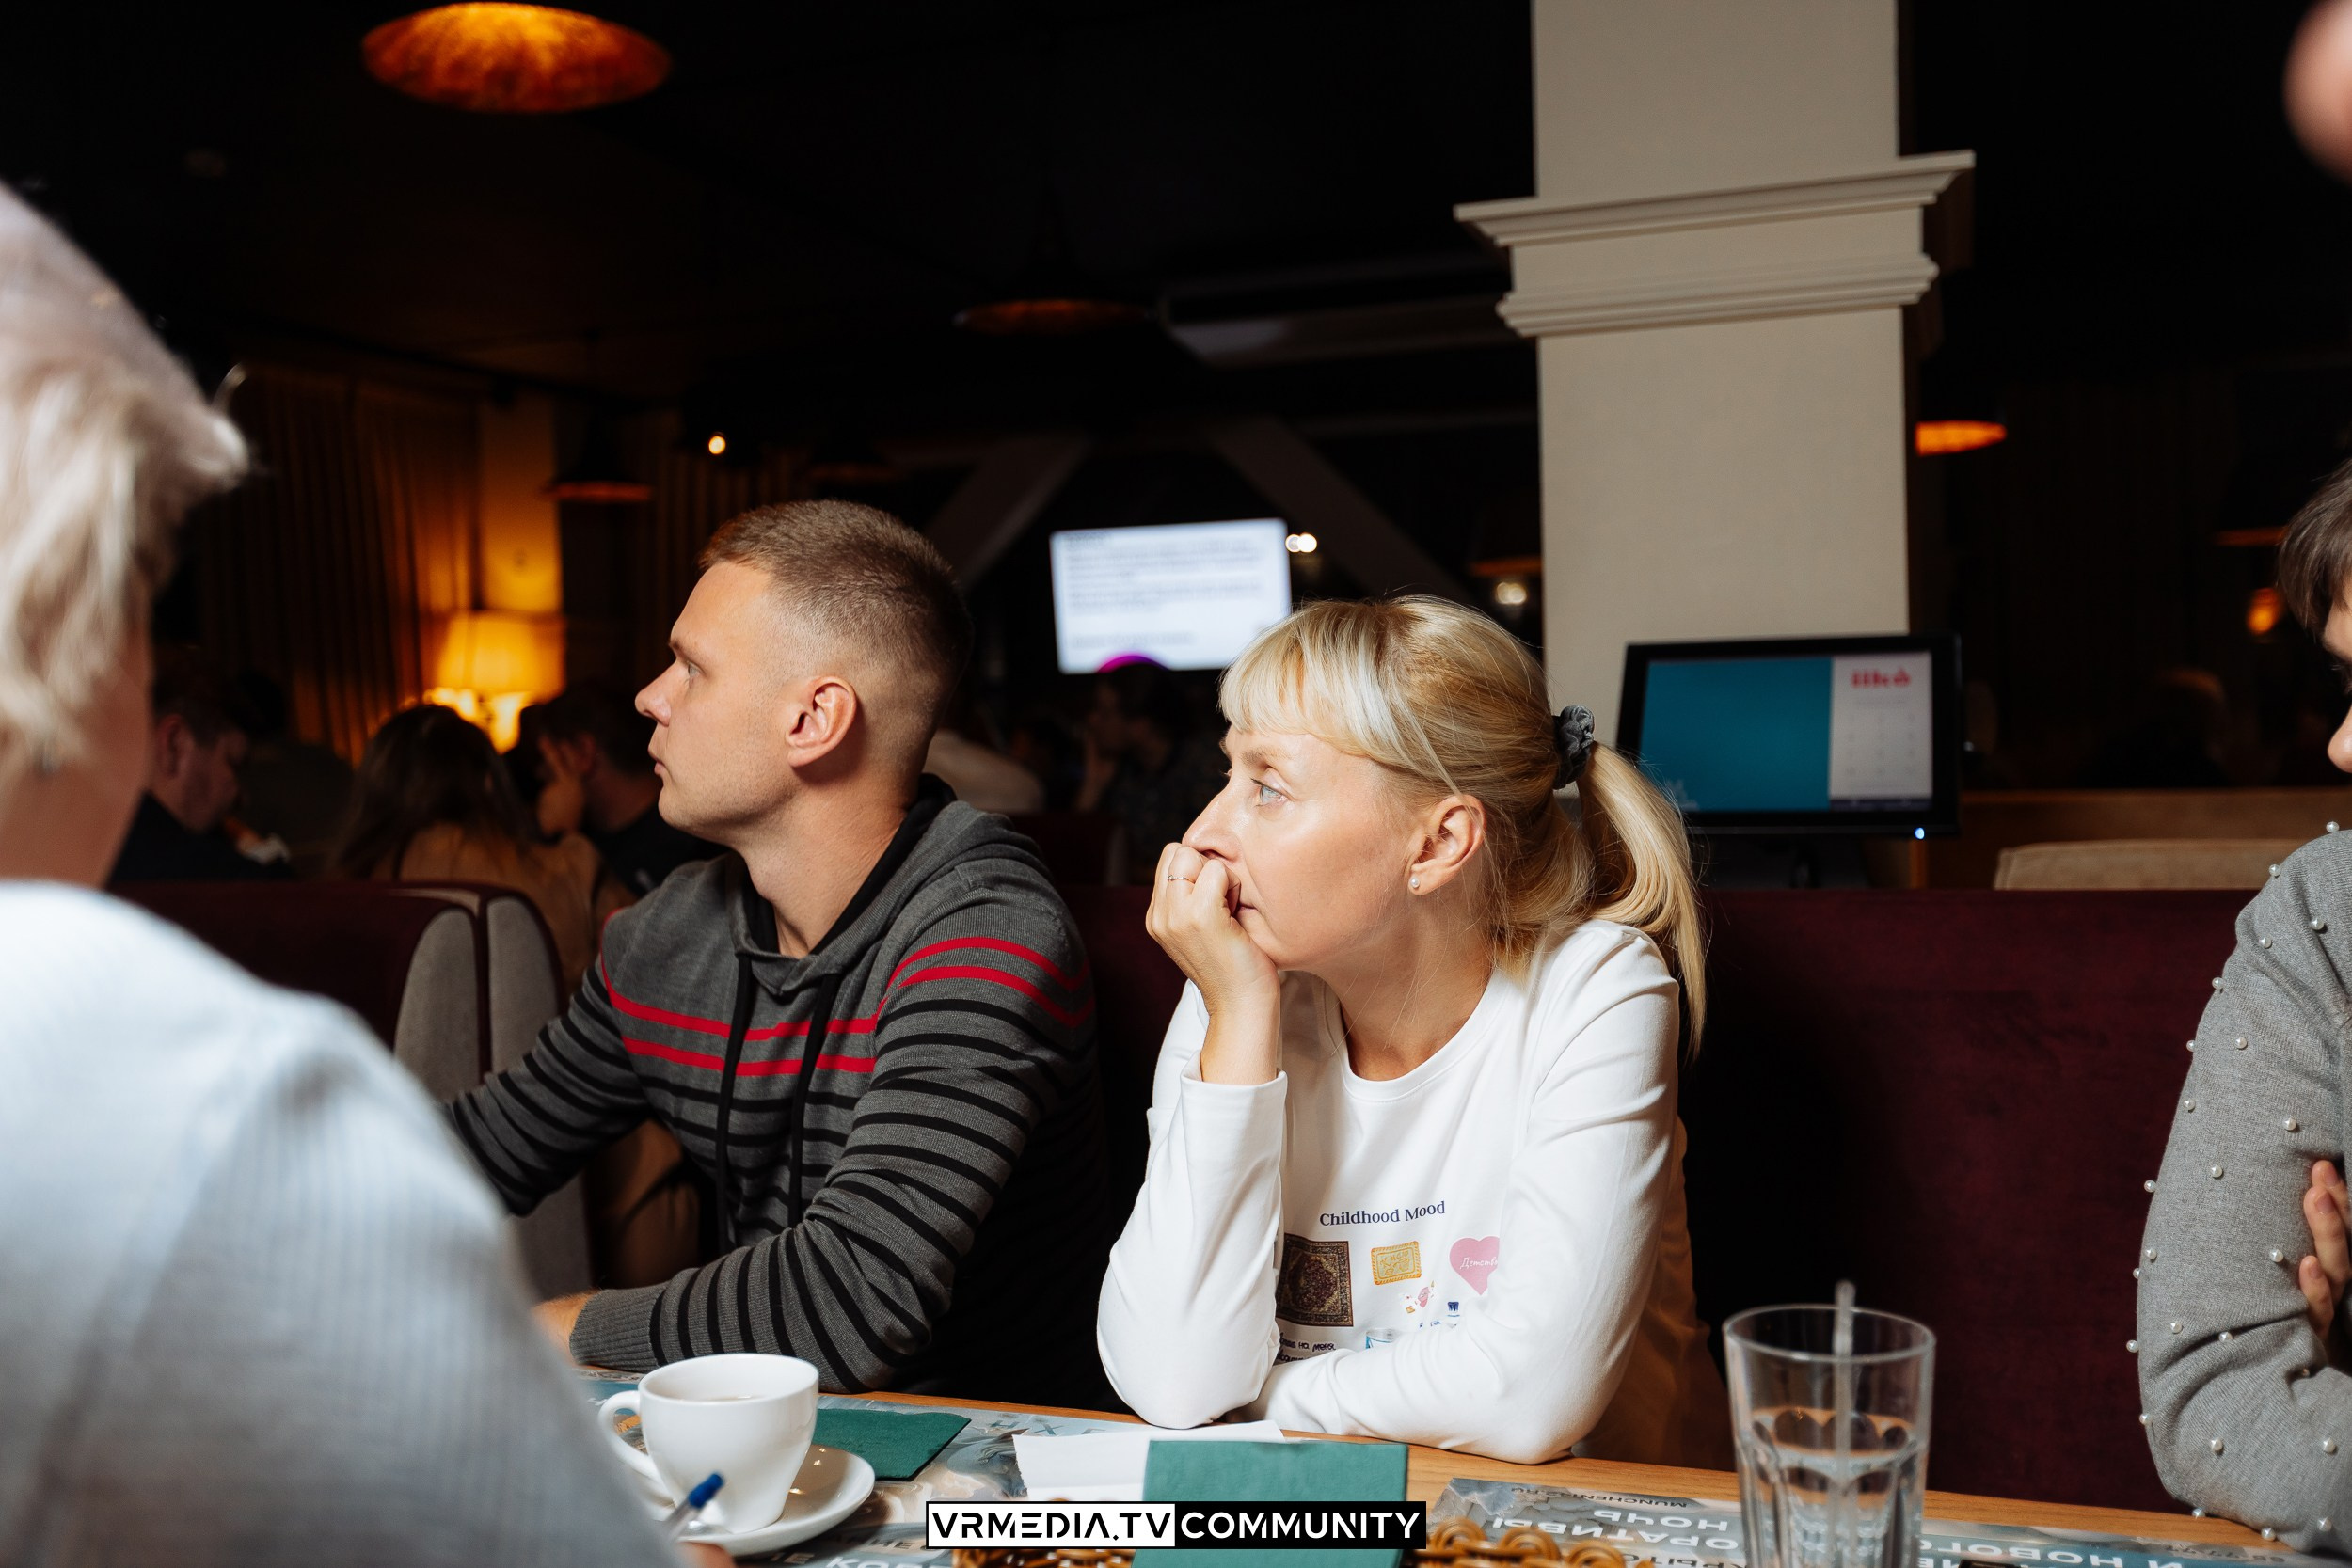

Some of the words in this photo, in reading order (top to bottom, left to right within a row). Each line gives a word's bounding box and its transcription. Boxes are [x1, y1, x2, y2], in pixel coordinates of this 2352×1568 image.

[1319, 1209, 1400, 1227] Childhood
[1405, 1200, 1446, 1221] Mood
[1459, 1256, 1499, 1270] Детство
[1492, 1516, 1739, 1550] ОРАТИВЫ
[1594, 1509, 1728, 1532] НОЧЬ
